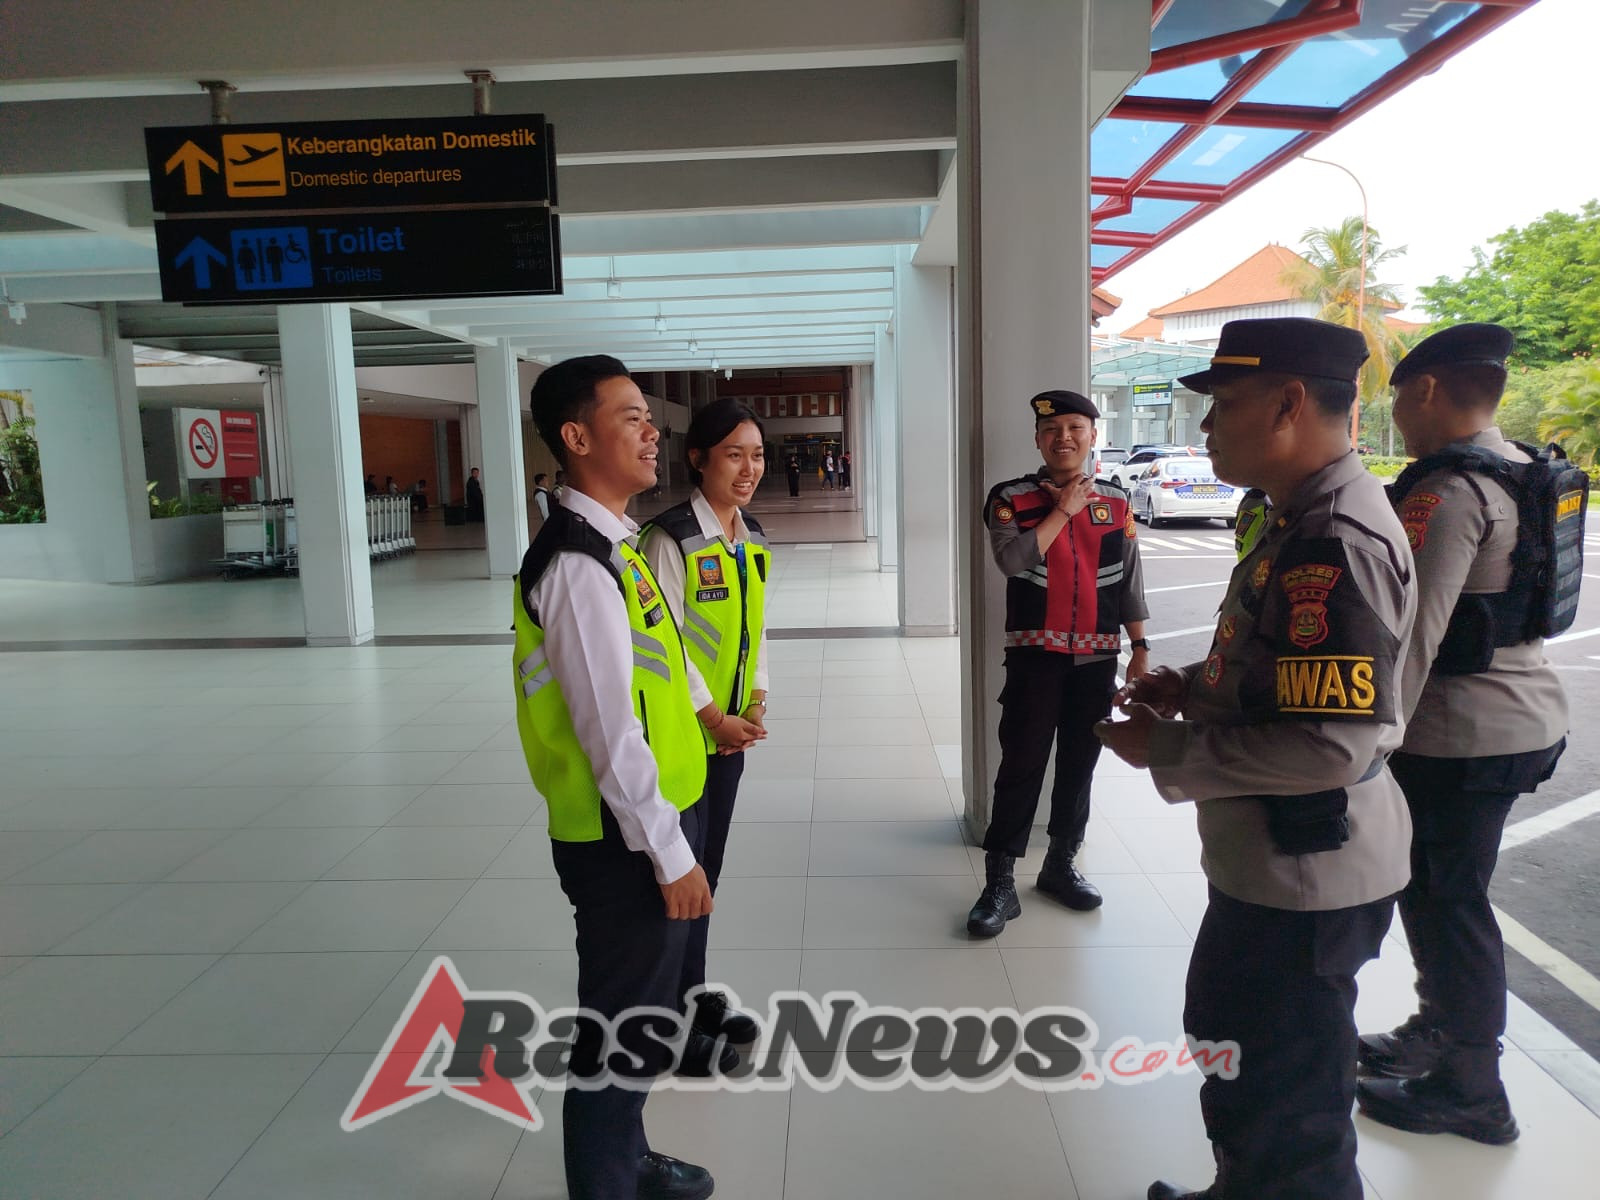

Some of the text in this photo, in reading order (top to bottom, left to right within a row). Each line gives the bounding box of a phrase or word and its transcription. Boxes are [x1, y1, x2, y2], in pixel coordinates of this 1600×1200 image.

[287, 128, 537, 157] Keberangkatan Domestik
[290, 167, 463, 188] Domestic departures
[317, 225, 406, 255] Toilet
[321, 264, 383, 284] Toilets
